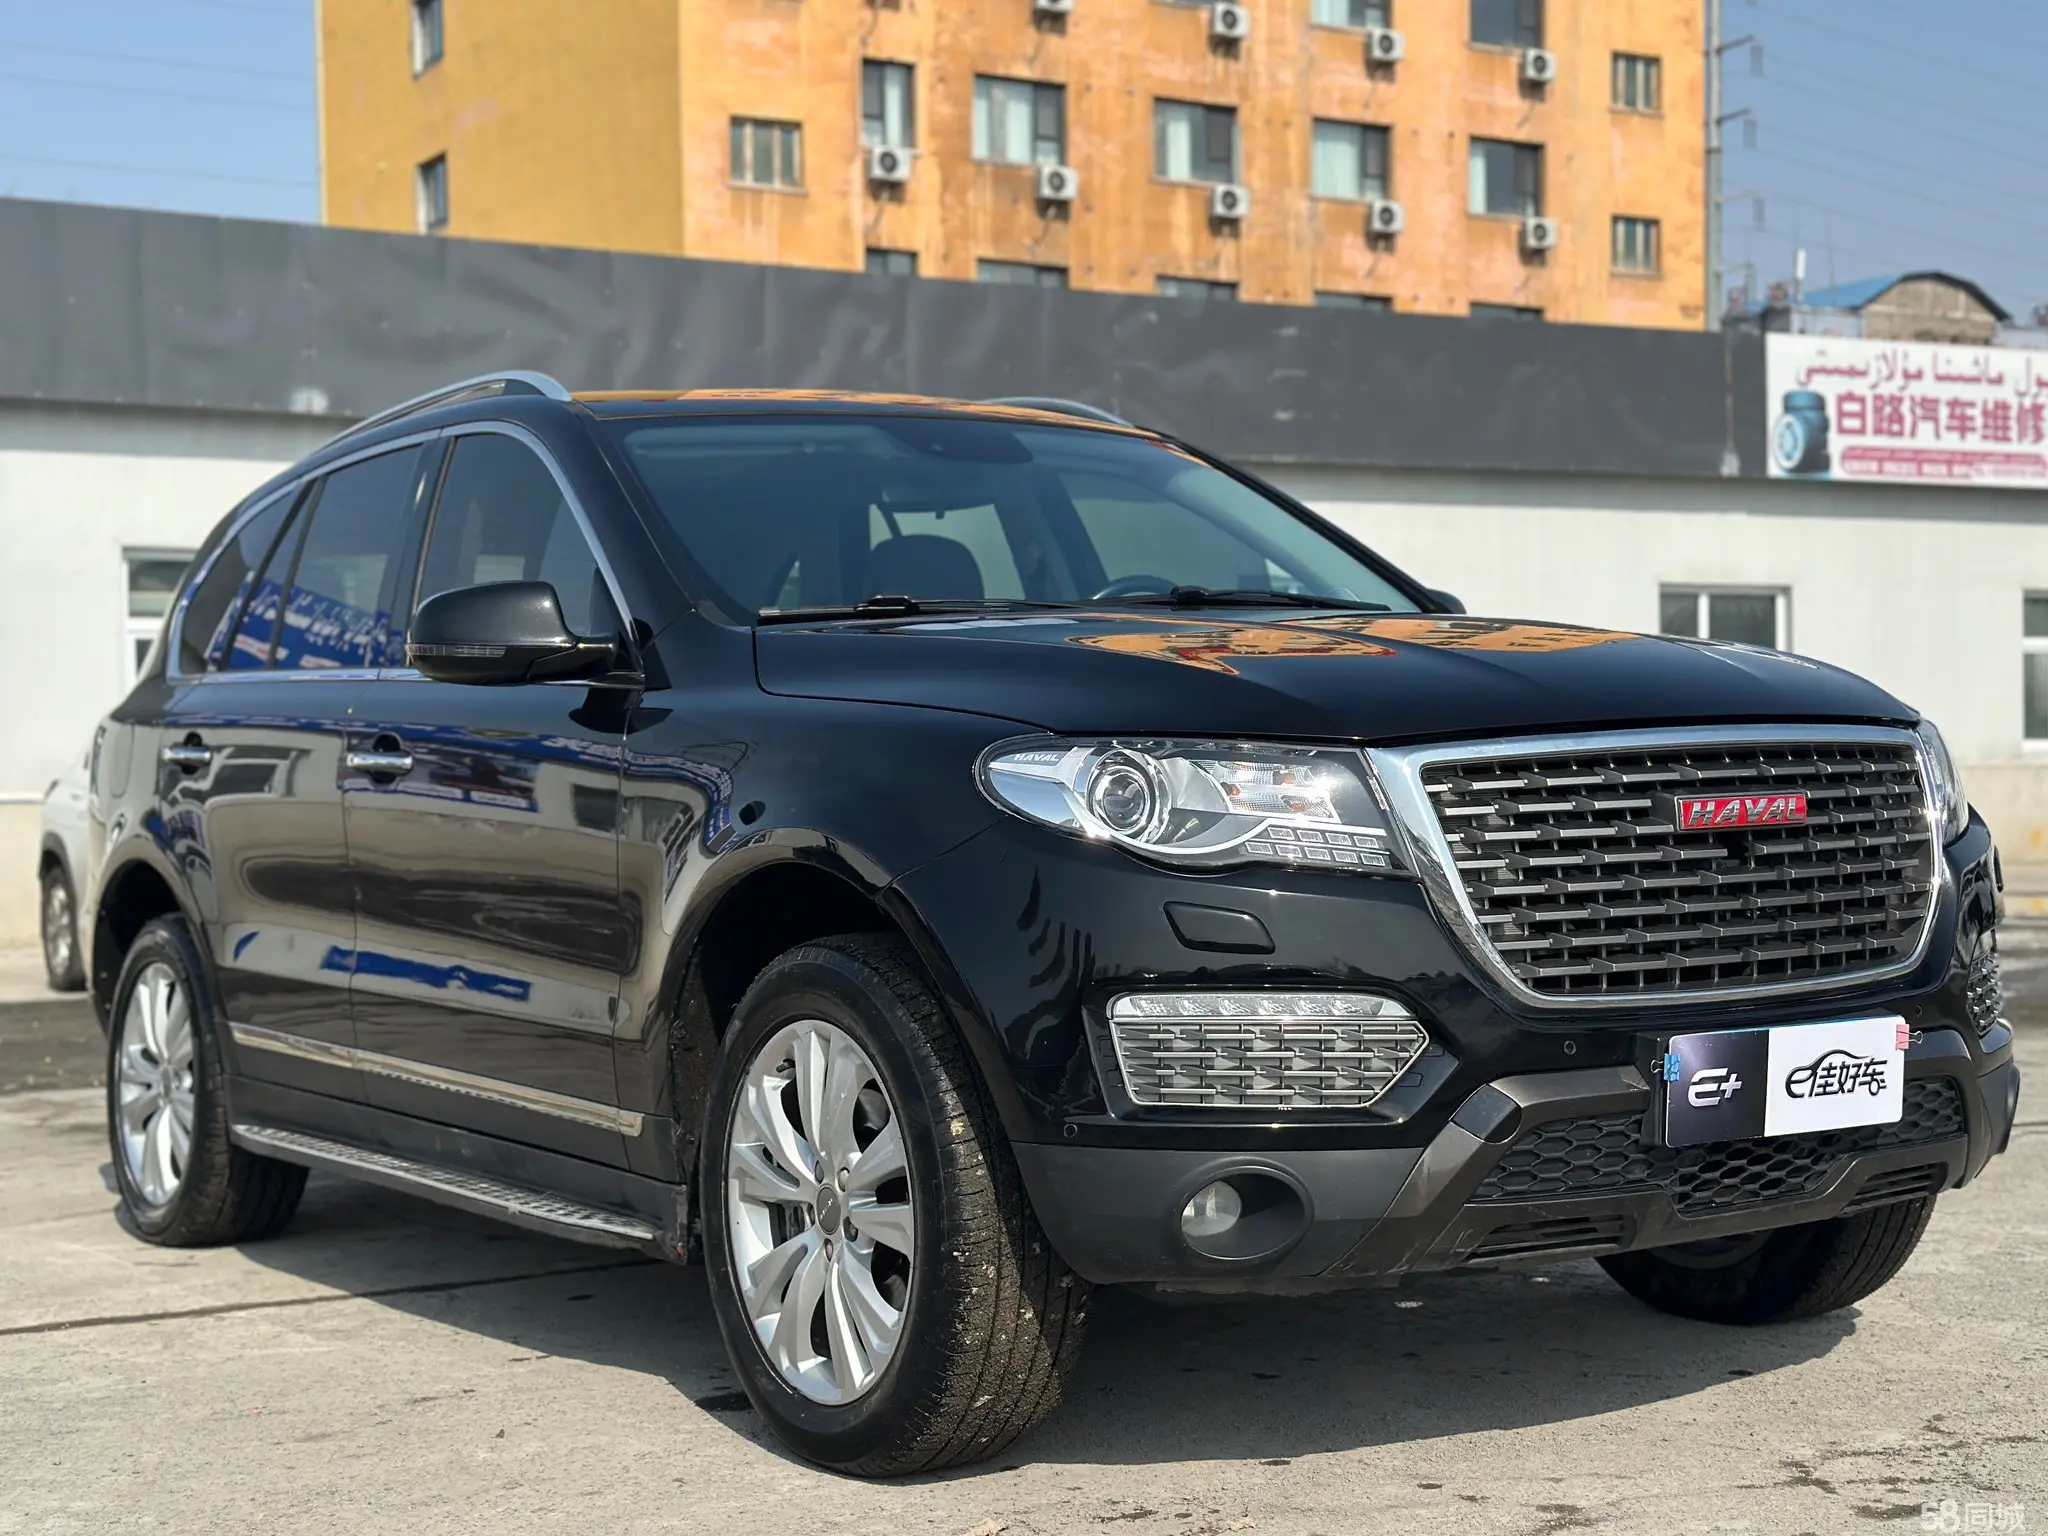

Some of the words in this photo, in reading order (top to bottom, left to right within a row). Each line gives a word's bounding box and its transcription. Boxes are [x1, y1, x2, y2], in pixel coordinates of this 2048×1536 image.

[1836, 391, 2044, 444] 白路汽车维修
[1013, 753, 1060, 761] HAVAL
[1688, 797, 1806, 826] HAVAL
